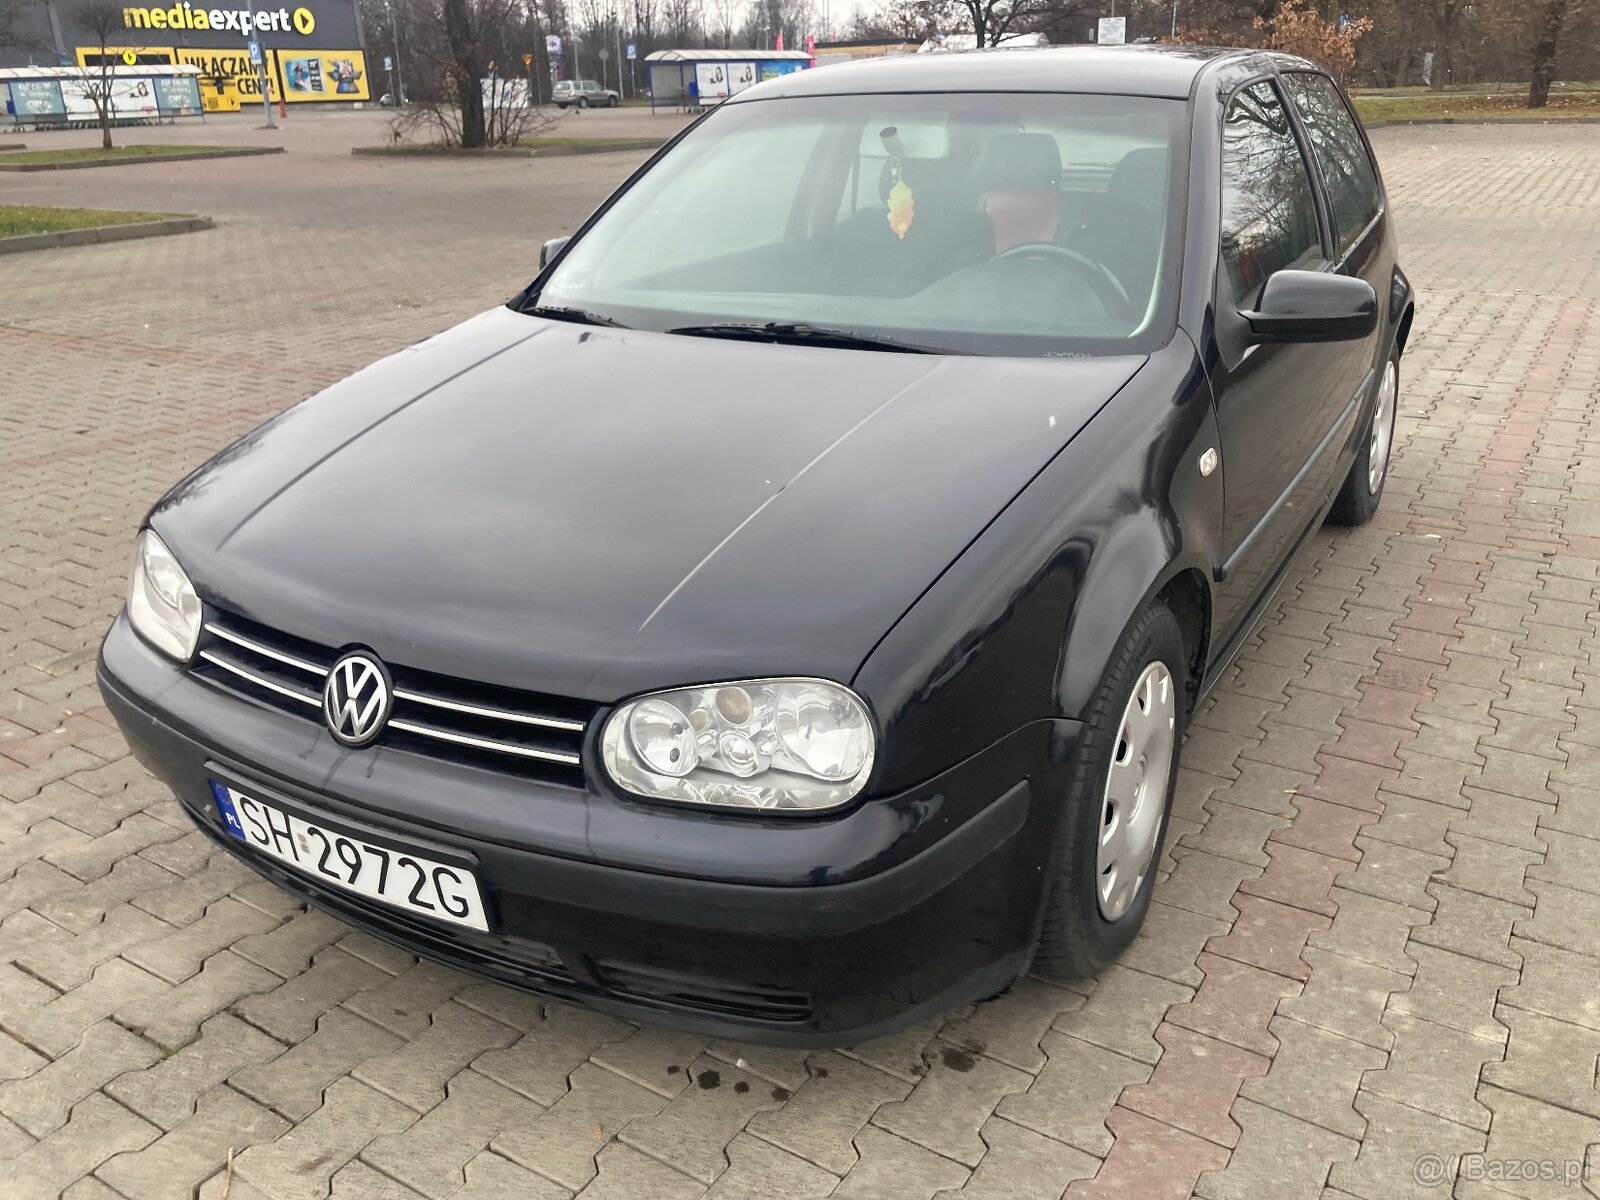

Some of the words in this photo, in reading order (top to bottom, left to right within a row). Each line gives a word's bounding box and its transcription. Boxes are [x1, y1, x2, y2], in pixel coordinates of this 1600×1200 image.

[123, 1, 292, 36] mediaexpert
[237, 78, 275, 95] CEN!
[225, 812, 241, 830] PL
[239, 796, 300, 862] SH
[307, 826, 469, 918] 2972G
